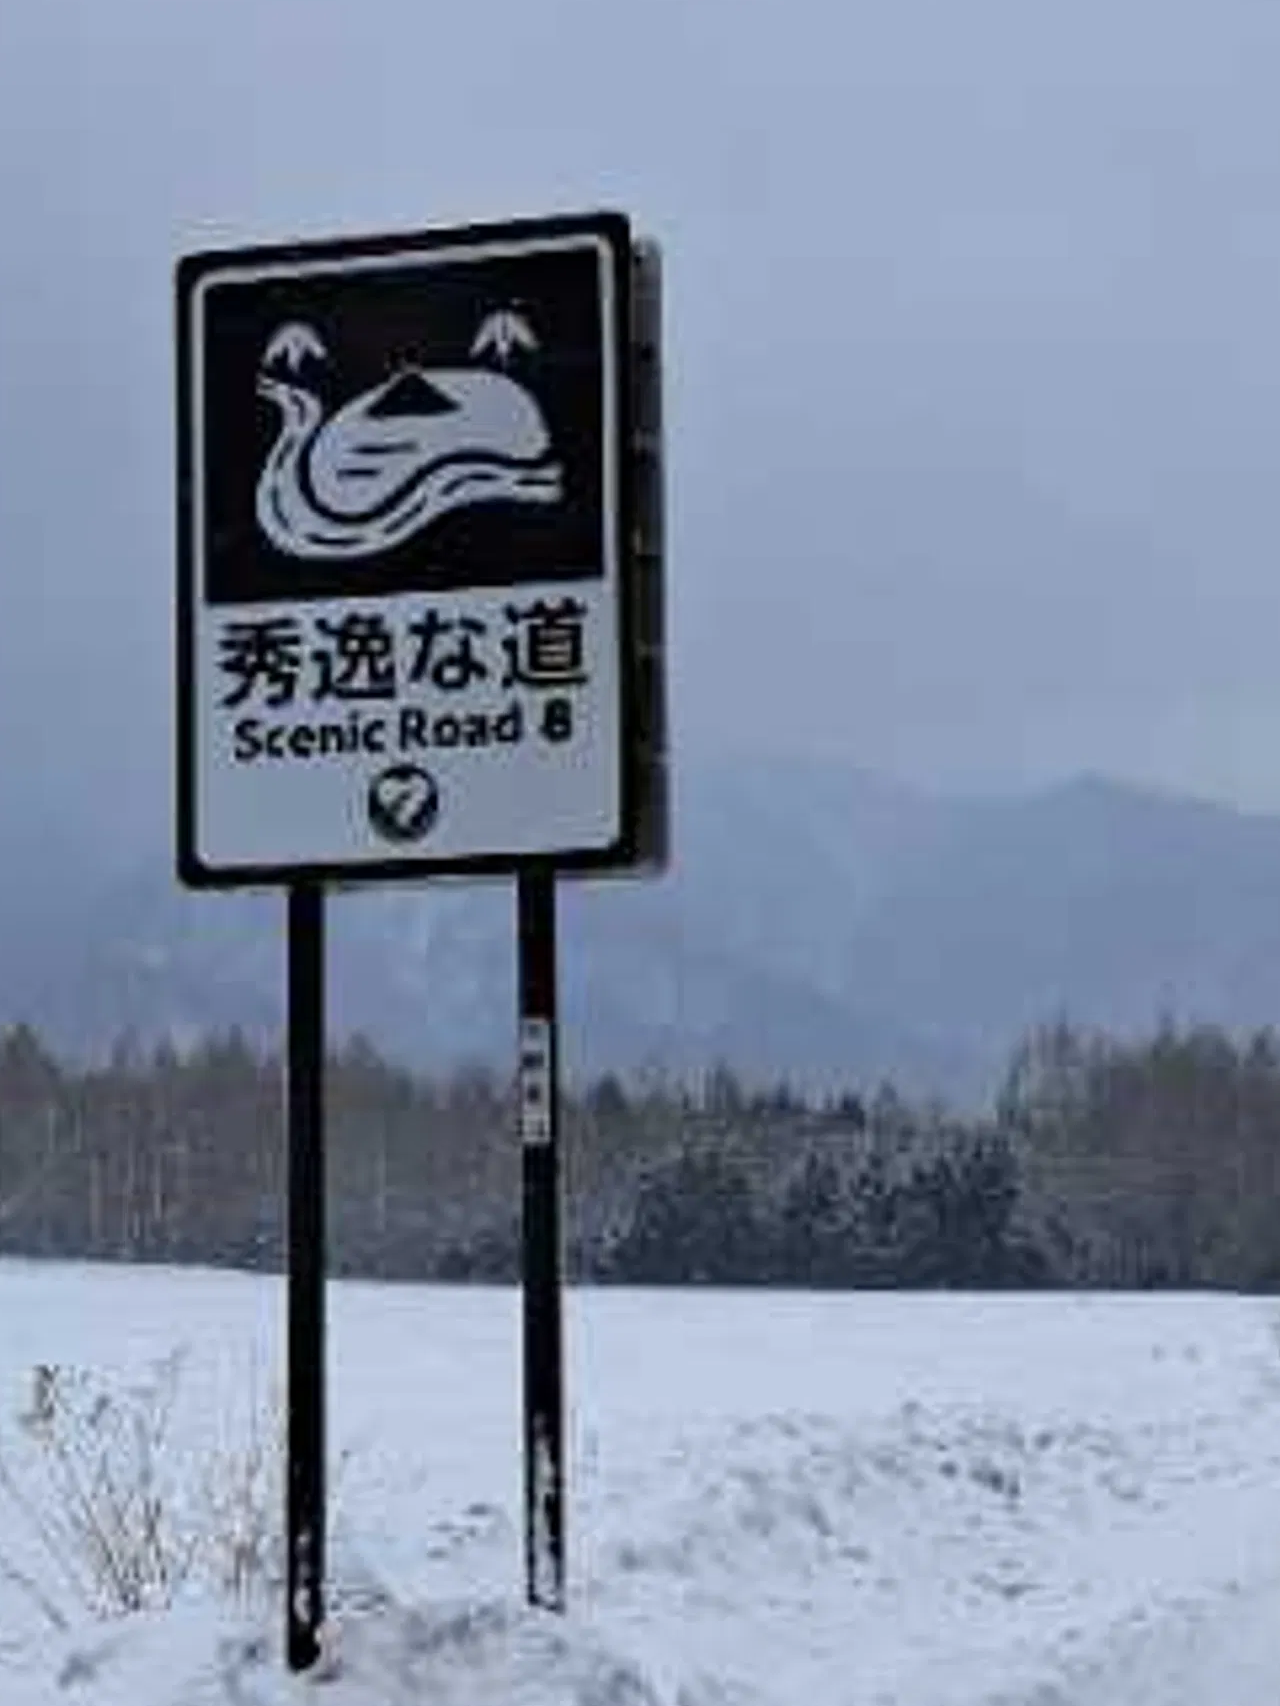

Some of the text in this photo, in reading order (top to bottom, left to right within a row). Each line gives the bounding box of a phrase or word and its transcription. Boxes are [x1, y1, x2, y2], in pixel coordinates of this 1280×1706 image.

[218, 596, 588, 708] 秀逸な道
[234, 707, 386, 762] Scenic
[399, 699, 523, 752] Road
